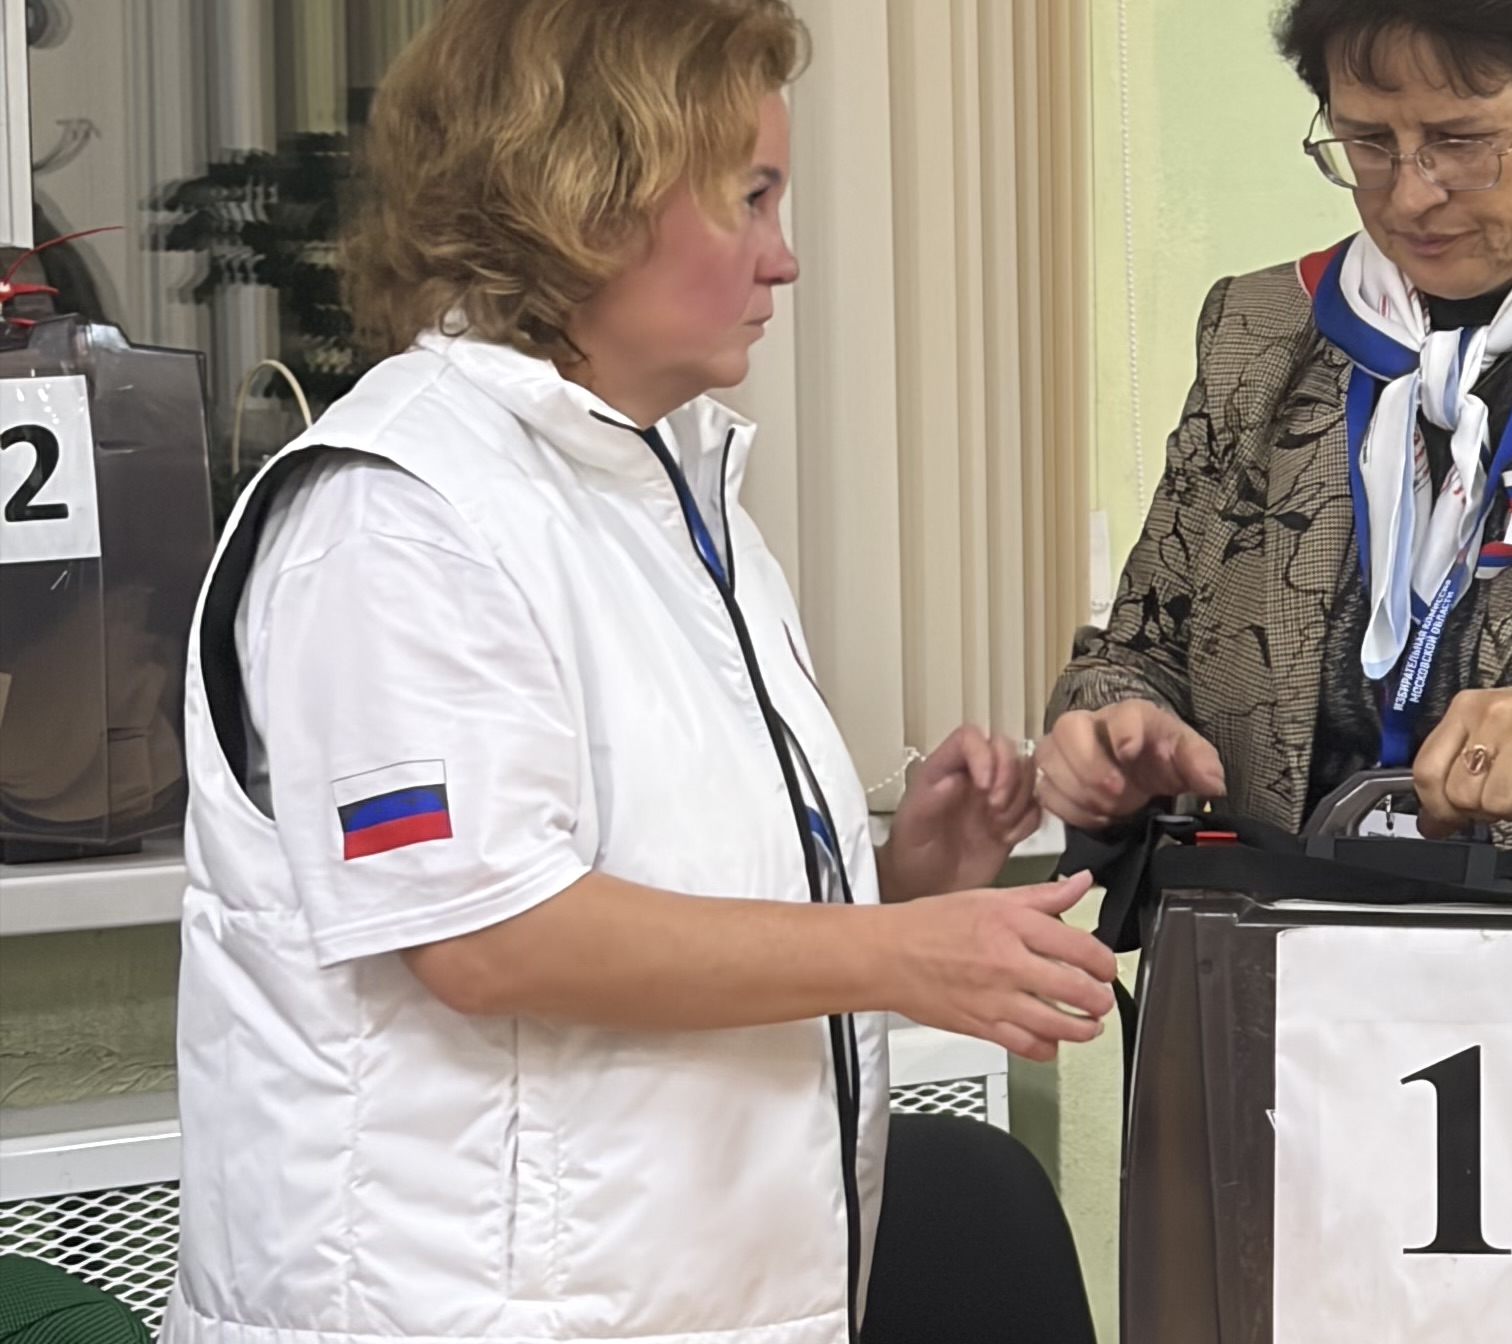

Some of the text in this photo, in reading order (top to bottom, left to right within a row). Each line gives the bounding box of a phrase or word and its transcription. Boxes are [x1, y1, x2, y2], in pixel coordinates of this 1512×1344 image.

[0, 424, 69, 523] 2
[1393, 630, 1428, 711] ИЗБИРАТЕЛЬНАЯ
[1409, 635, 1438, 704] МОСКОВСКОЙ
[1400, 1044, 1512, 1255] 1
